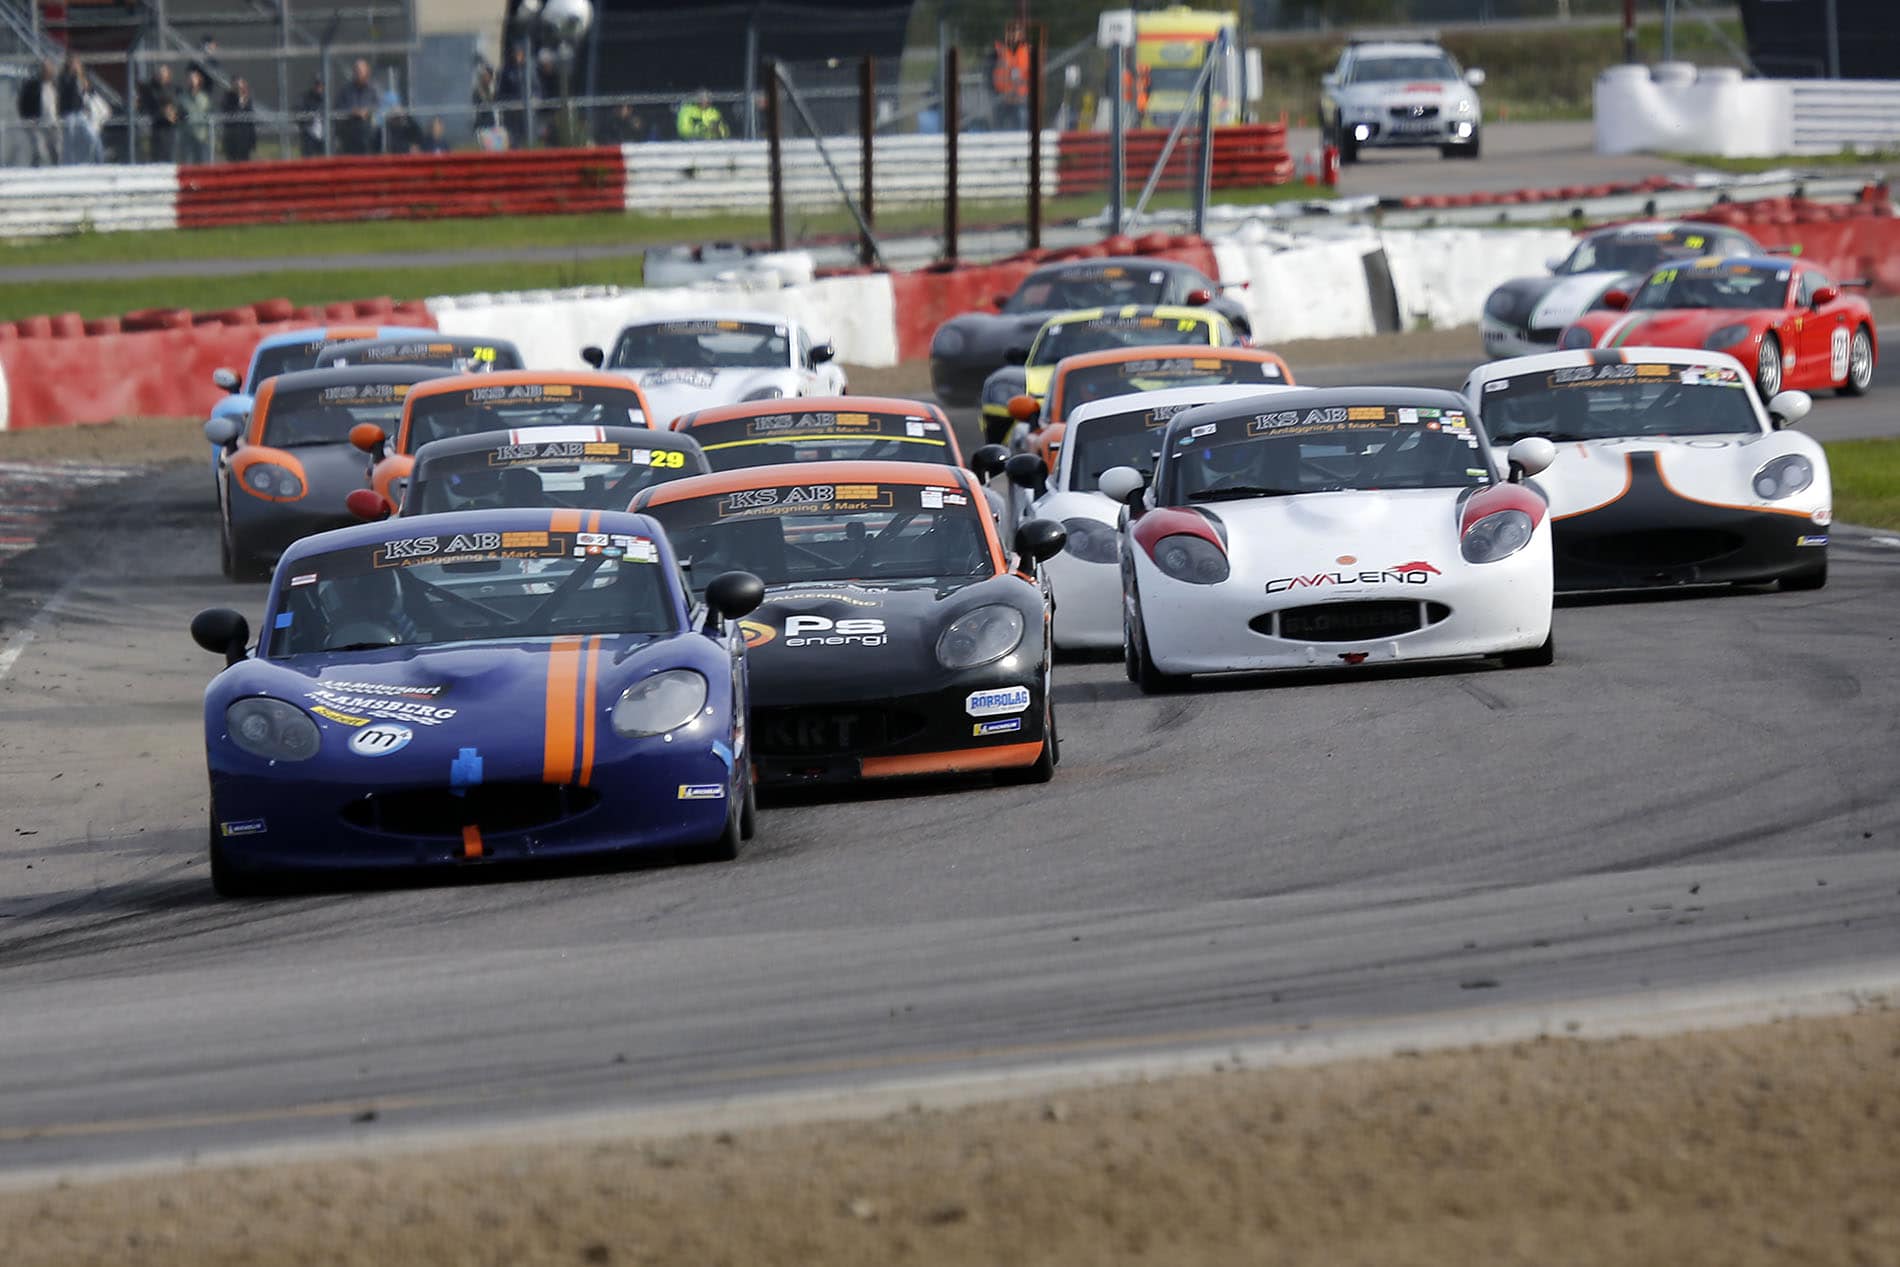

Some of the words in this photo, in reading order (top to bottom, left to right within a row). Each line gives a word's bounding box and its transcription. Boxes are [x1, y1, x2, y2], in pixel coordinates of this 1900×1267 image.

[754, 415, 793, 430] KS
[795, 413, 836, 428] AB
[1255, 411, 1299, 430] KS
[1302, 408, 1348, 425] AB
[497, 443, 538, 459] KS
[541, 442, 584, 457] AB
[650, 450, 685, 468] 29
[729, 488, 779, 509] KS
[783, 485, 834, 504] AB
[835, 502, 868, 510] Mark
[384, 536, 438, 560] KS
[444, 532, 501, 553] AB
[501, 550, 539, 559] Mark
[1265, 571, 1428, 594] CAVALENO
[785, 615, 886, 637] Ps
[786, 634, 888, 647] energi
